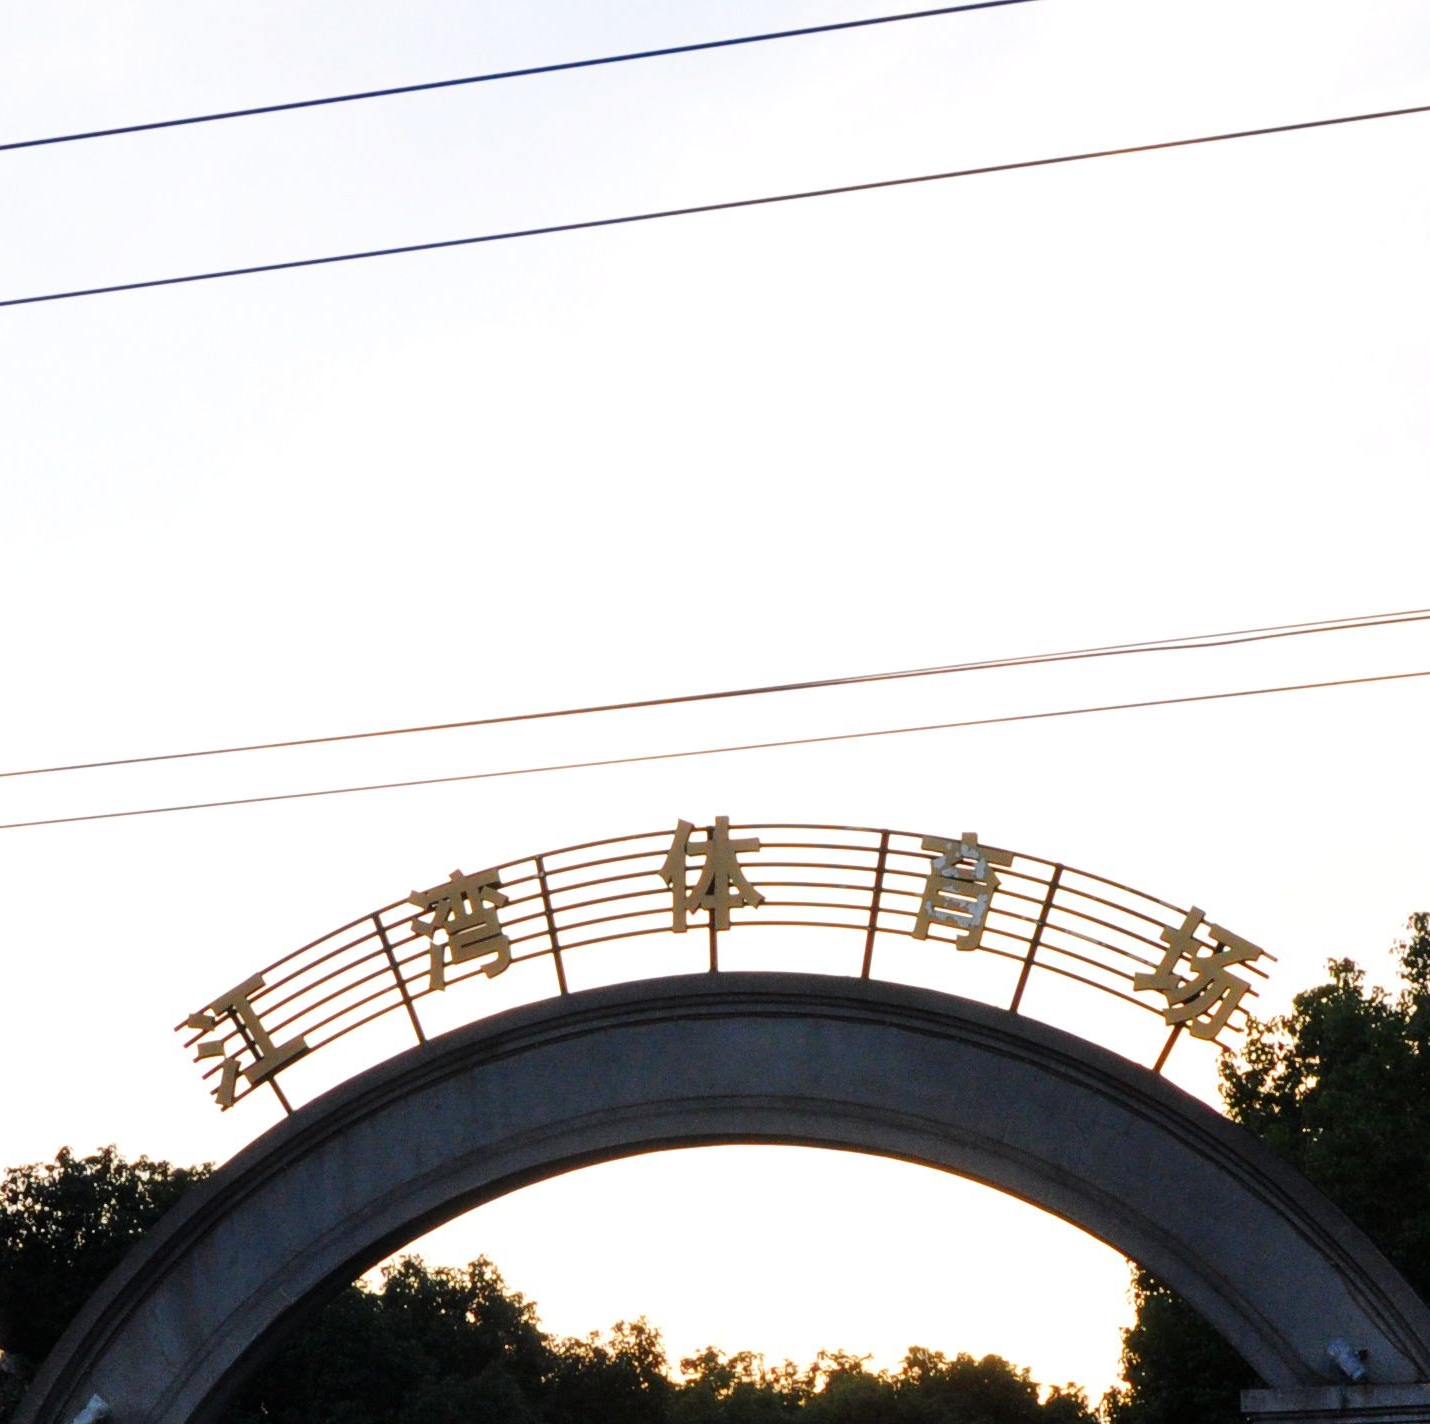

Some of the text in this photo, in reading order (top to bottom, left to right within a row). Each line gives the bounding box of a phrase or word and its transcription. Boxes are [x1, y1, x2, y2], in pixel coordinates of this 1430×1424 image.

[185, 815, 1261, 1108] 江湾体育场
